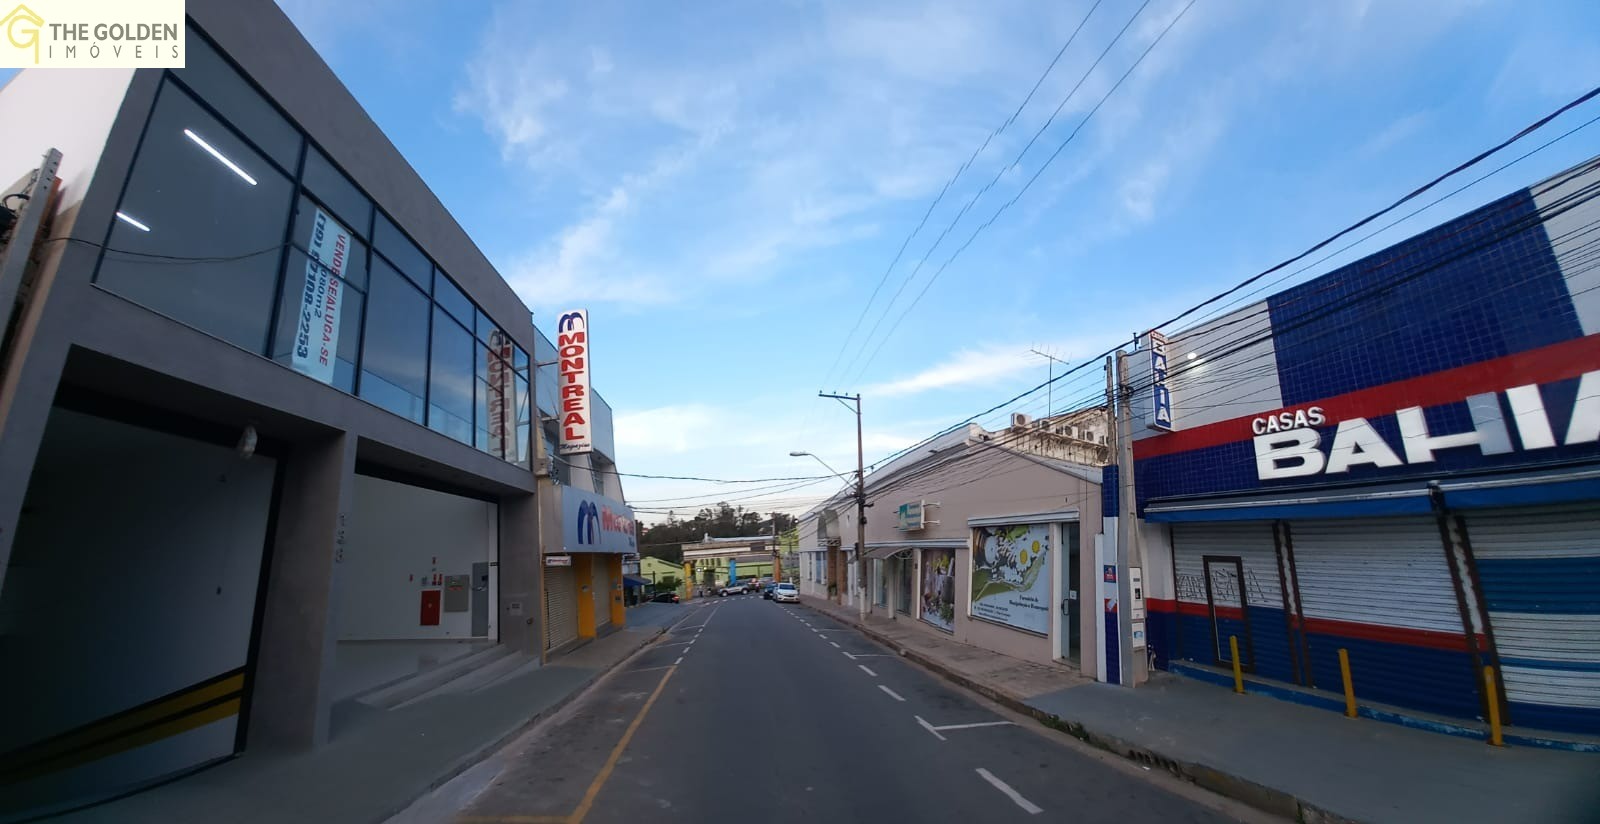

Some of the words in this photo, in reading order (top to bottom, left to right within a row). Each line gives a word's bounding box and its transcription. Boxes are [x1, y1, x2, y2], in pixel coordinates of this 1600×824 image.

[314, 262, 328, 319] 080m2
[558, 331, 585, 441] MONTREAL
[1252, 406, 1326, 436] CASAS
